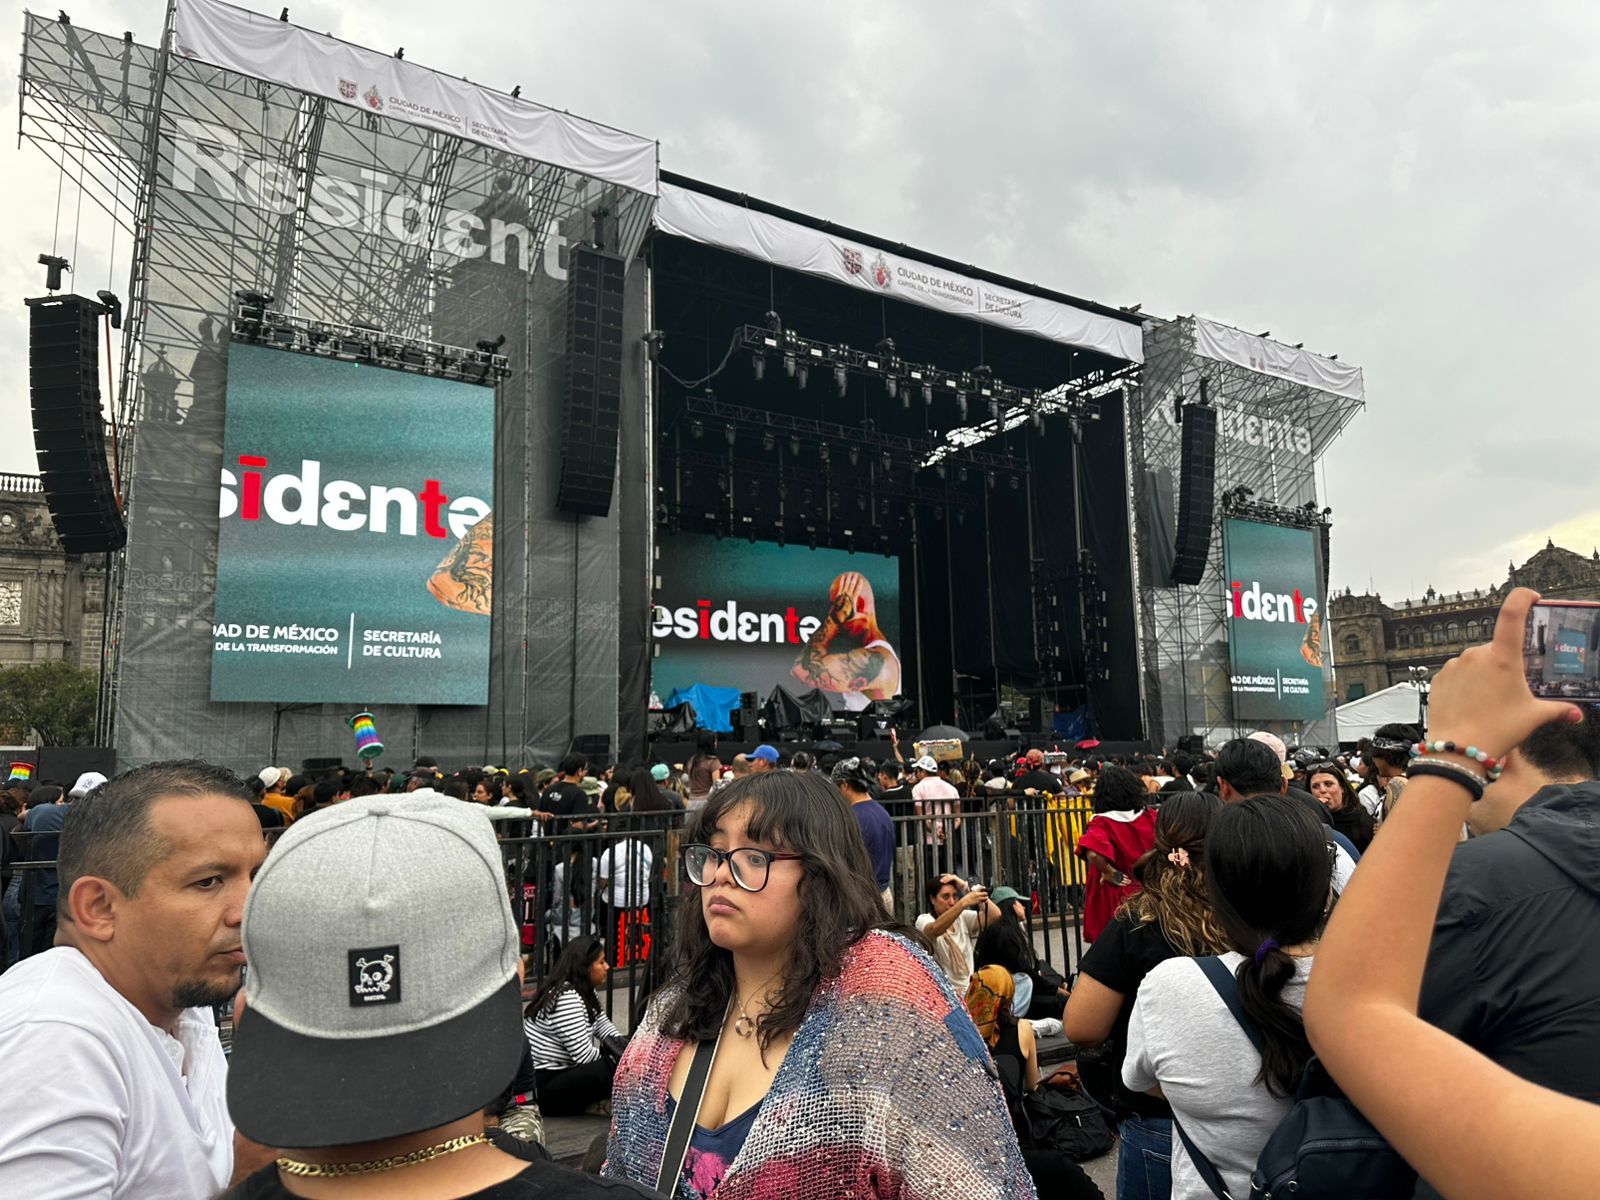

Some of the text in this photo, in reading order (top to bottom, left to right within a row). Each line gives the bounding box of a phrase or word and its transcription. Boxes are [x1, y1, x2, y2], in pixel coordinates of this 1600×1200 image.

[389, 96, 461, 123] CIUDAD DE MÉXICO
[897, 267, 974, 297] CIUDAD DE MÉXICO
[245, 624, 270, 639] DE
[273, 623, 339, 642] MÉXICO
[363, 629, 442, 645] SECRETARÍA
[215, 642, 339, 655] DE LA TRANSFORMACIÓN
[363, 645, 442, 659] DE CULTURA
